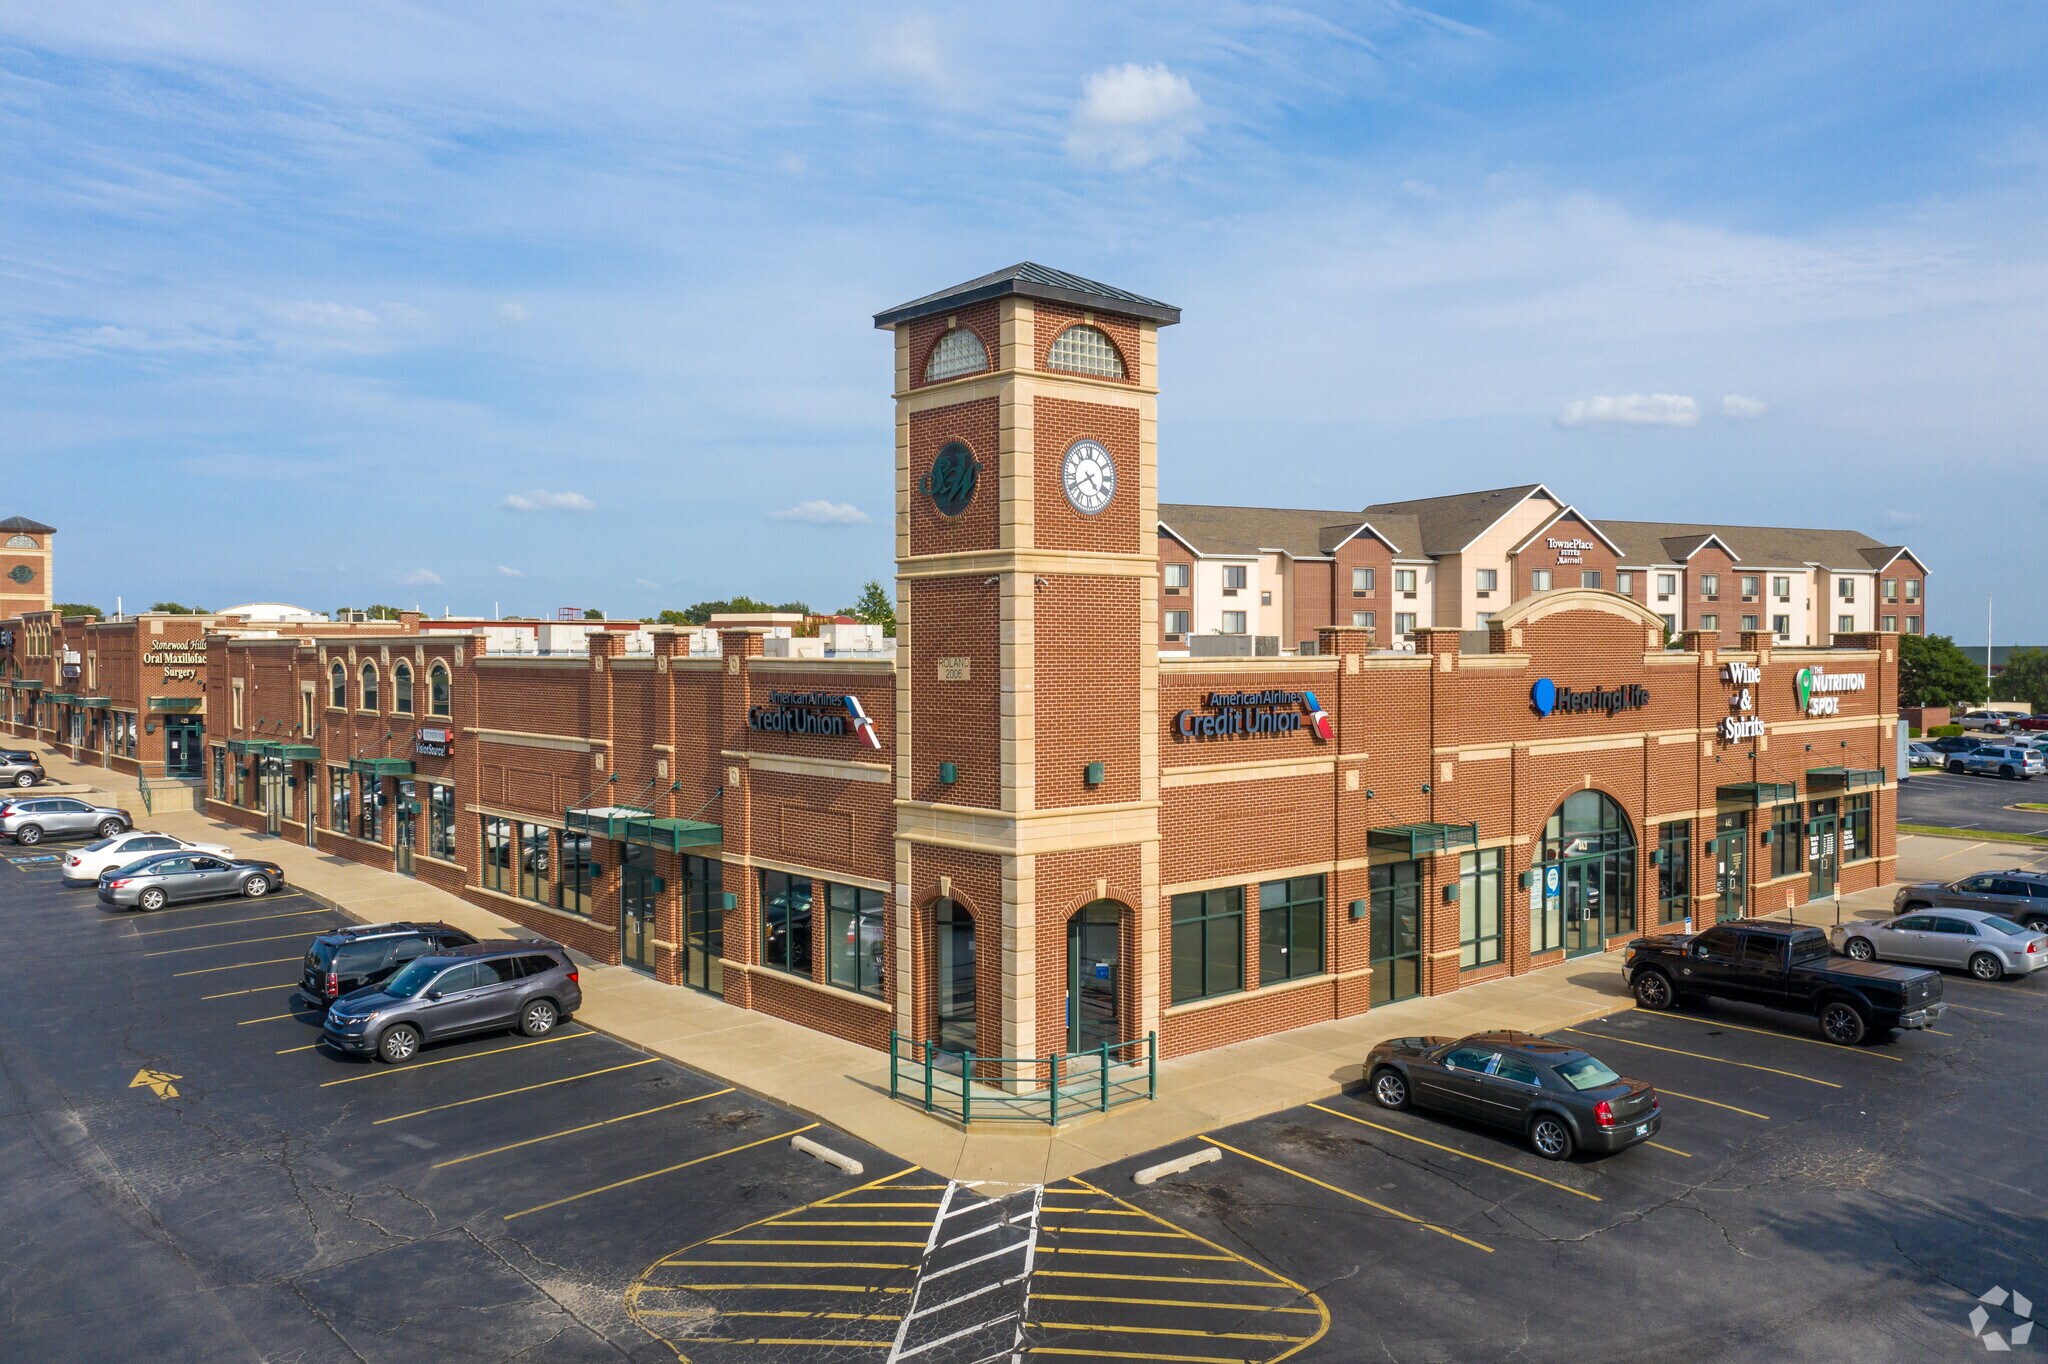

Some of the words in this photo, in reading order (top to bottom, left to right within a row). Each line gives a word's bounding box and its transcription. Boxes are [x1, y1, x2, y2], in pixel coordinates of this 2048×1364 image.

[1547, 538, 1594, 549] TownePlace
[152, 639, 189, 650] Stonewood
[190, 639, 207, 652] Hills
[143, 652, 163, 664] Oral
[939, 657, 970, 668] ROLAND
[164, 666, 196, 679] Surgery
[946, 669, 963, 679] 2006
[1729, 662, 1761, 684] Wine
[1814, 666, 1824, 674] THE
[1812, 673, 1866, 692] NUTRITION
[768, 690, 807, 704] American
[808, 692, 842, 706] Airlines
[1210, 691, 1262, 706] American
[1263, 690, 1302, 704] Airlines
[1559, 684, 1649, 713] HearingLife
[1740, 688, 1752, 710] &
[749, 706, 793, 733] Credit
[795, 708, 844, 736] Union
[1179, 707, 1243, 736] Credit
[1245, 706, 1301, 732] Union
[1725, 715, 1765, 744] Spirits
